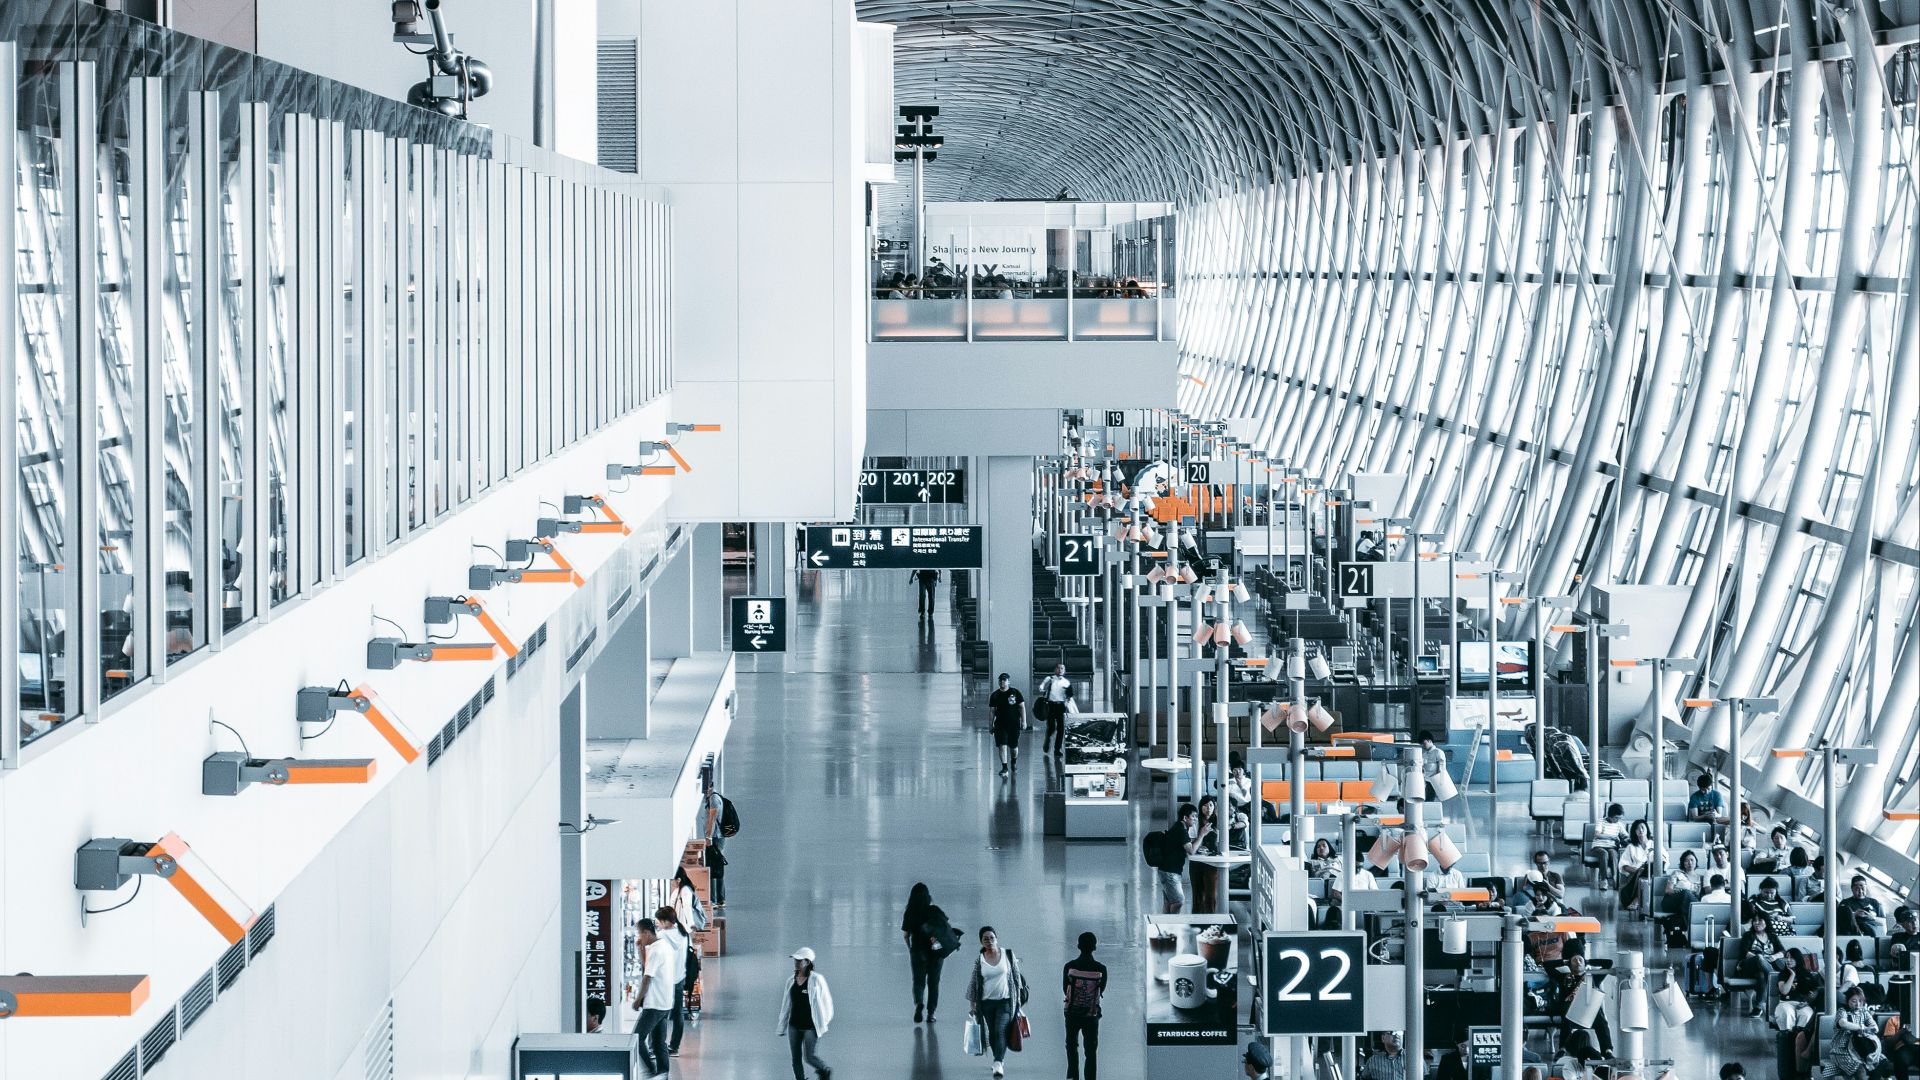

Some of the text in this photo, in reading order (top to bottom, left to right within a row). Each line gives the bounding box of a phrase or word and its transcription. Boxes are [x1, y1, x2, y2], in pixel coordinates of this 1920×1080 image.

[979, 245, 999, 253] New
[1110, 412, 1122, 425] 19
[1191, 464, 1206, 482] 20
[853, 542, 884, 551] Arrivals
[1064, 540, 1093, 562] 21
[1347, 568, 1369, 594] 21
[1277, 949, 1353, 1001] 22
[1157, 1030, 1200, 1038] STARBUCKS
